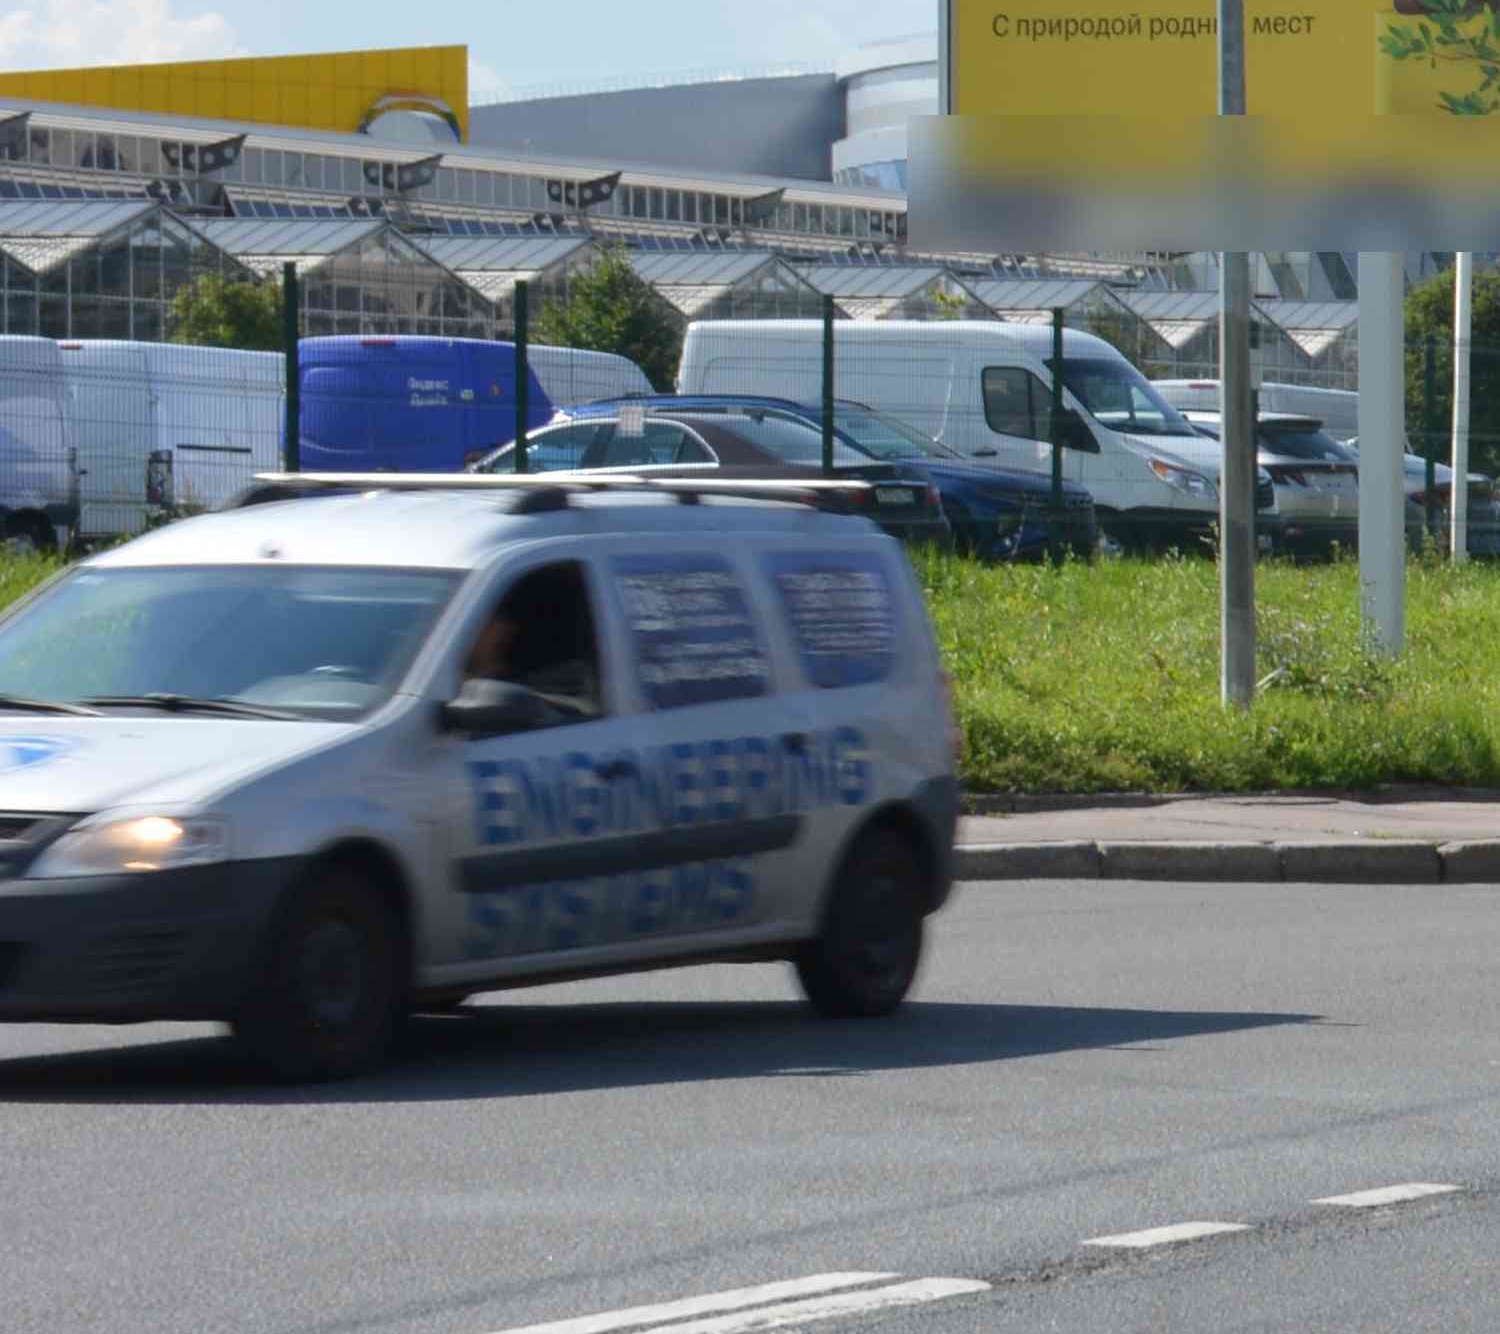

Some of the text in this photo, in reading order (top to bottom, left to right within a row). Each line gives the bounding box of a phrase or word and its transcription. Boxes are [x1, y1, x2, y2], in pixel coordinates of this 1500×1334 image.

[992, 13, 1315, 41] С природой родн мест
